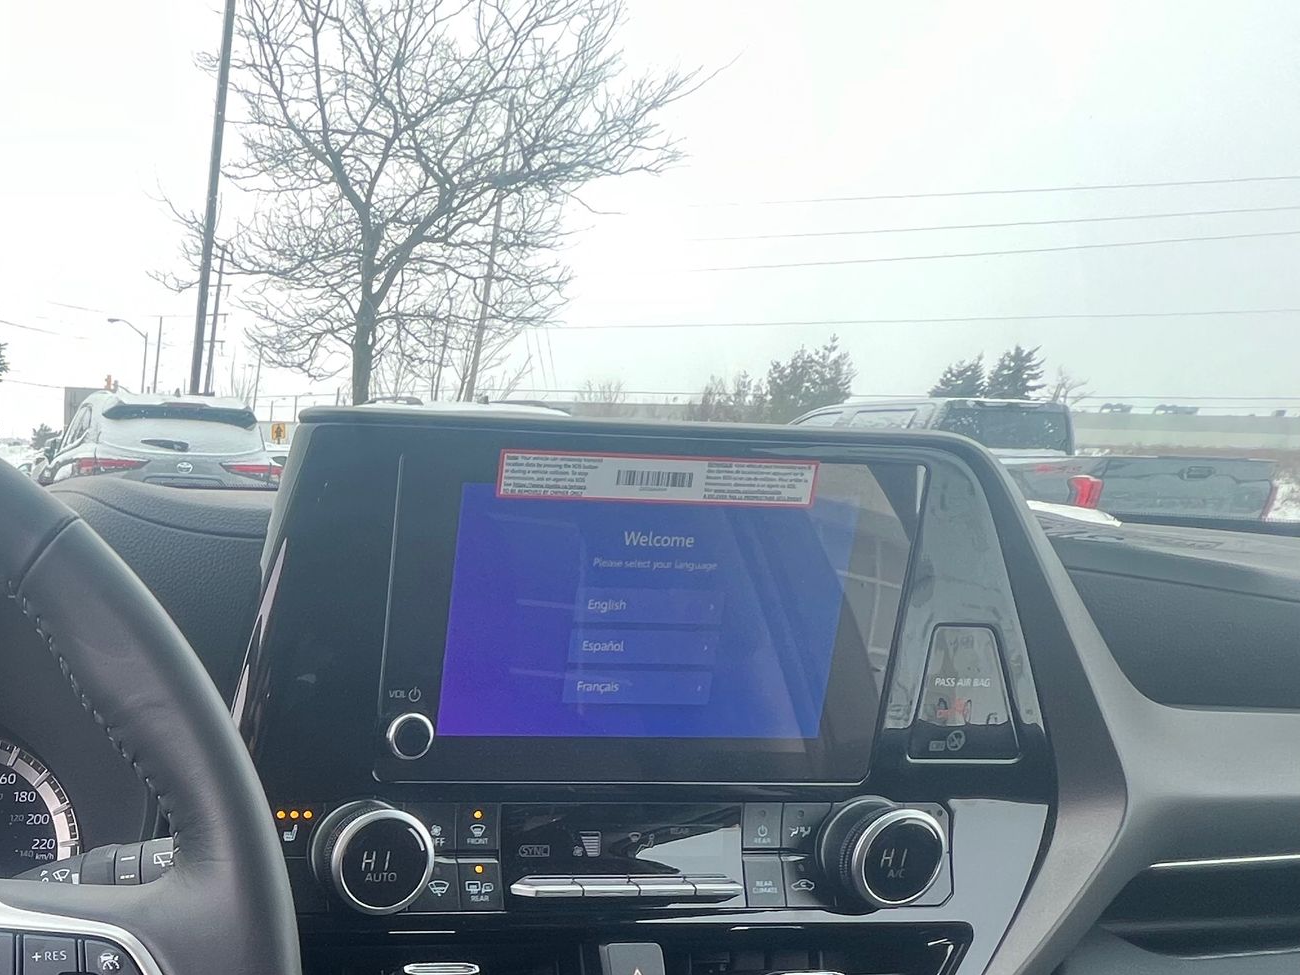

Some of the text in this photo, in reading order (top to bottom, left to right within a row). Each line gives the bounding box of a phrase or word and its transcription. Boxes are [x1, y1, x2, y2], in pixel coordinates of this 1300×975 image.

[624, 531, 695, 548] Welcome
[593, 557, 718, 572] Please select your language
[588, 599, 627, 613] English
[582, 640, 625, 653] Español
[576, 681, 620, 694] Français
[934, 678, 991, 688] PASS AIR BAG
[389, 690, 406, 698] VOL
[14, 792, 36, 802] 180
[10, 814, 24, 822] 120
[26, 814, 50, 824] 200
[32, 838, 56, 850] 220
[20, 850, 34, 858] 140
[35, 852, 54, 860] km/h
[522, 846, 549, 856] SYNC
[361, 850, 390, 872] HI
[880, 848, 908, 868] HI
[364, 872, 398, 882] AUTO
[887, 868, 906, 878] A/C
